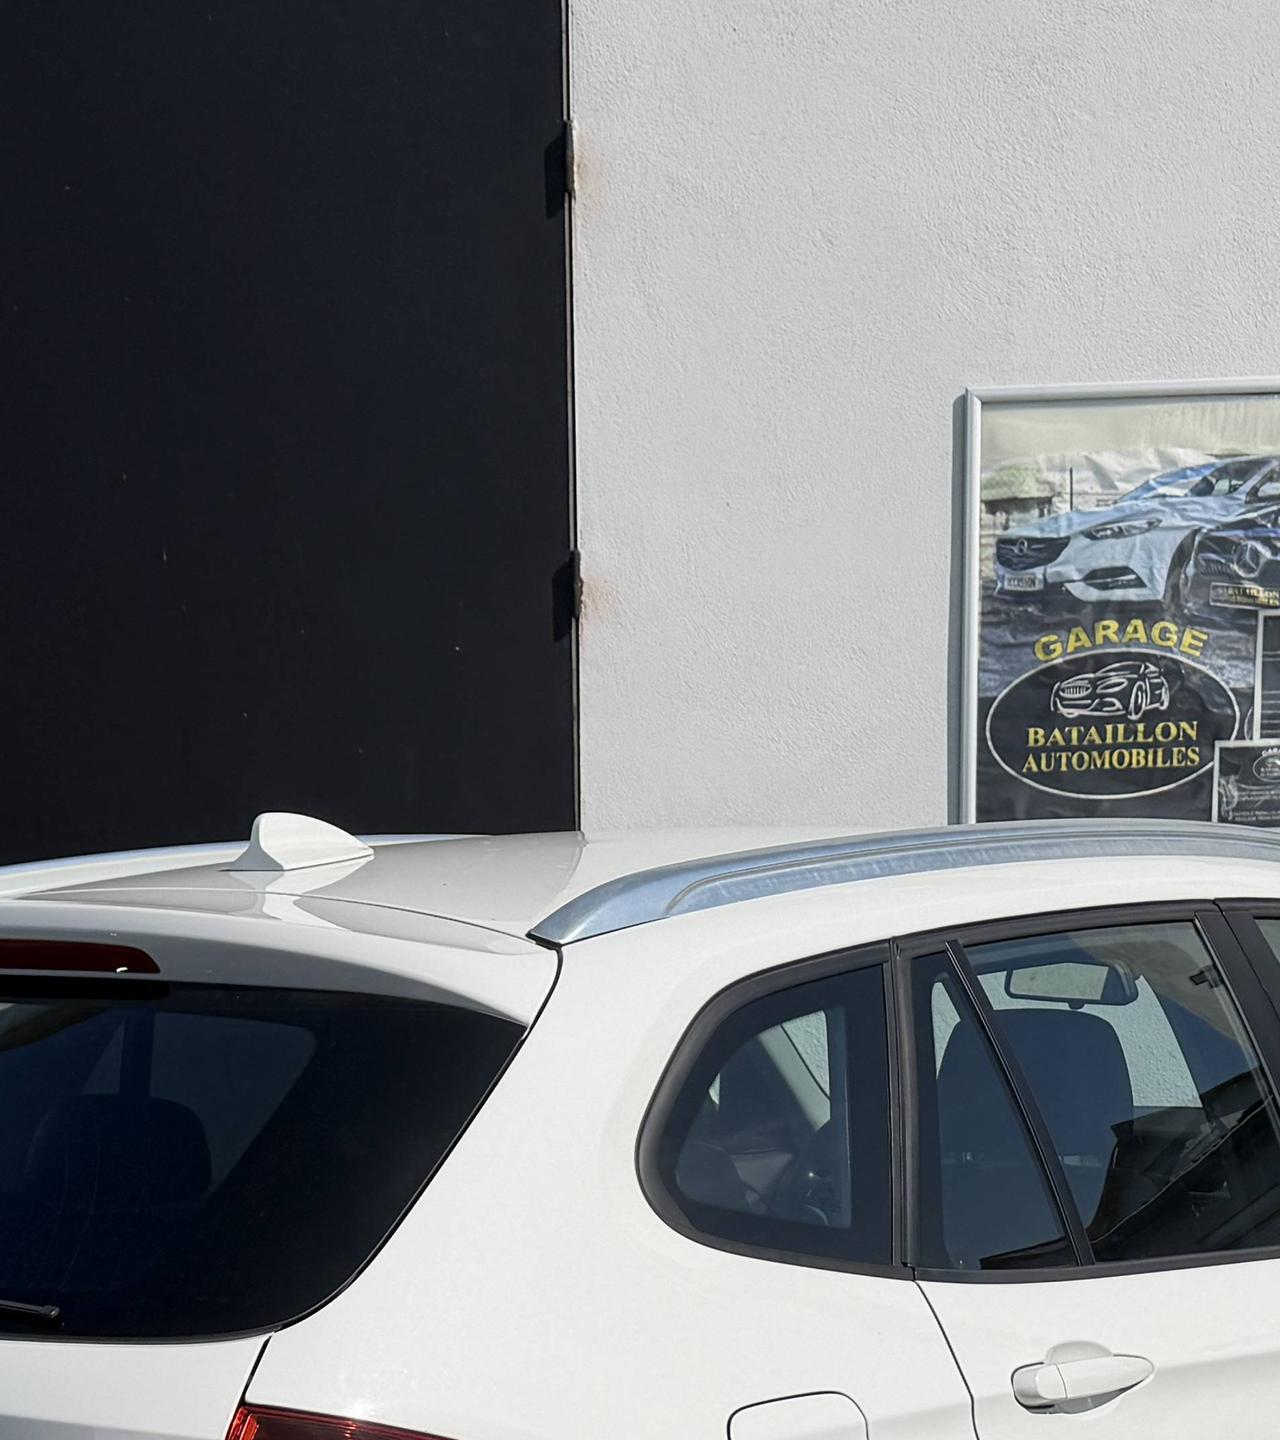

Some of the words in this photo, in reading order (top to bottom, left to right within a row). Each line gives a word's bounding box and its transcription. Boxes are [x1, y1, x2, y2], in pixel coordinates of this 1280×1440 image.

[1034, 619, 1209, 662] GARAGE
[1026, 720, 1198, 748] BATAILLON
[1022, 746, 1200, 773] AUTOMOBILES
